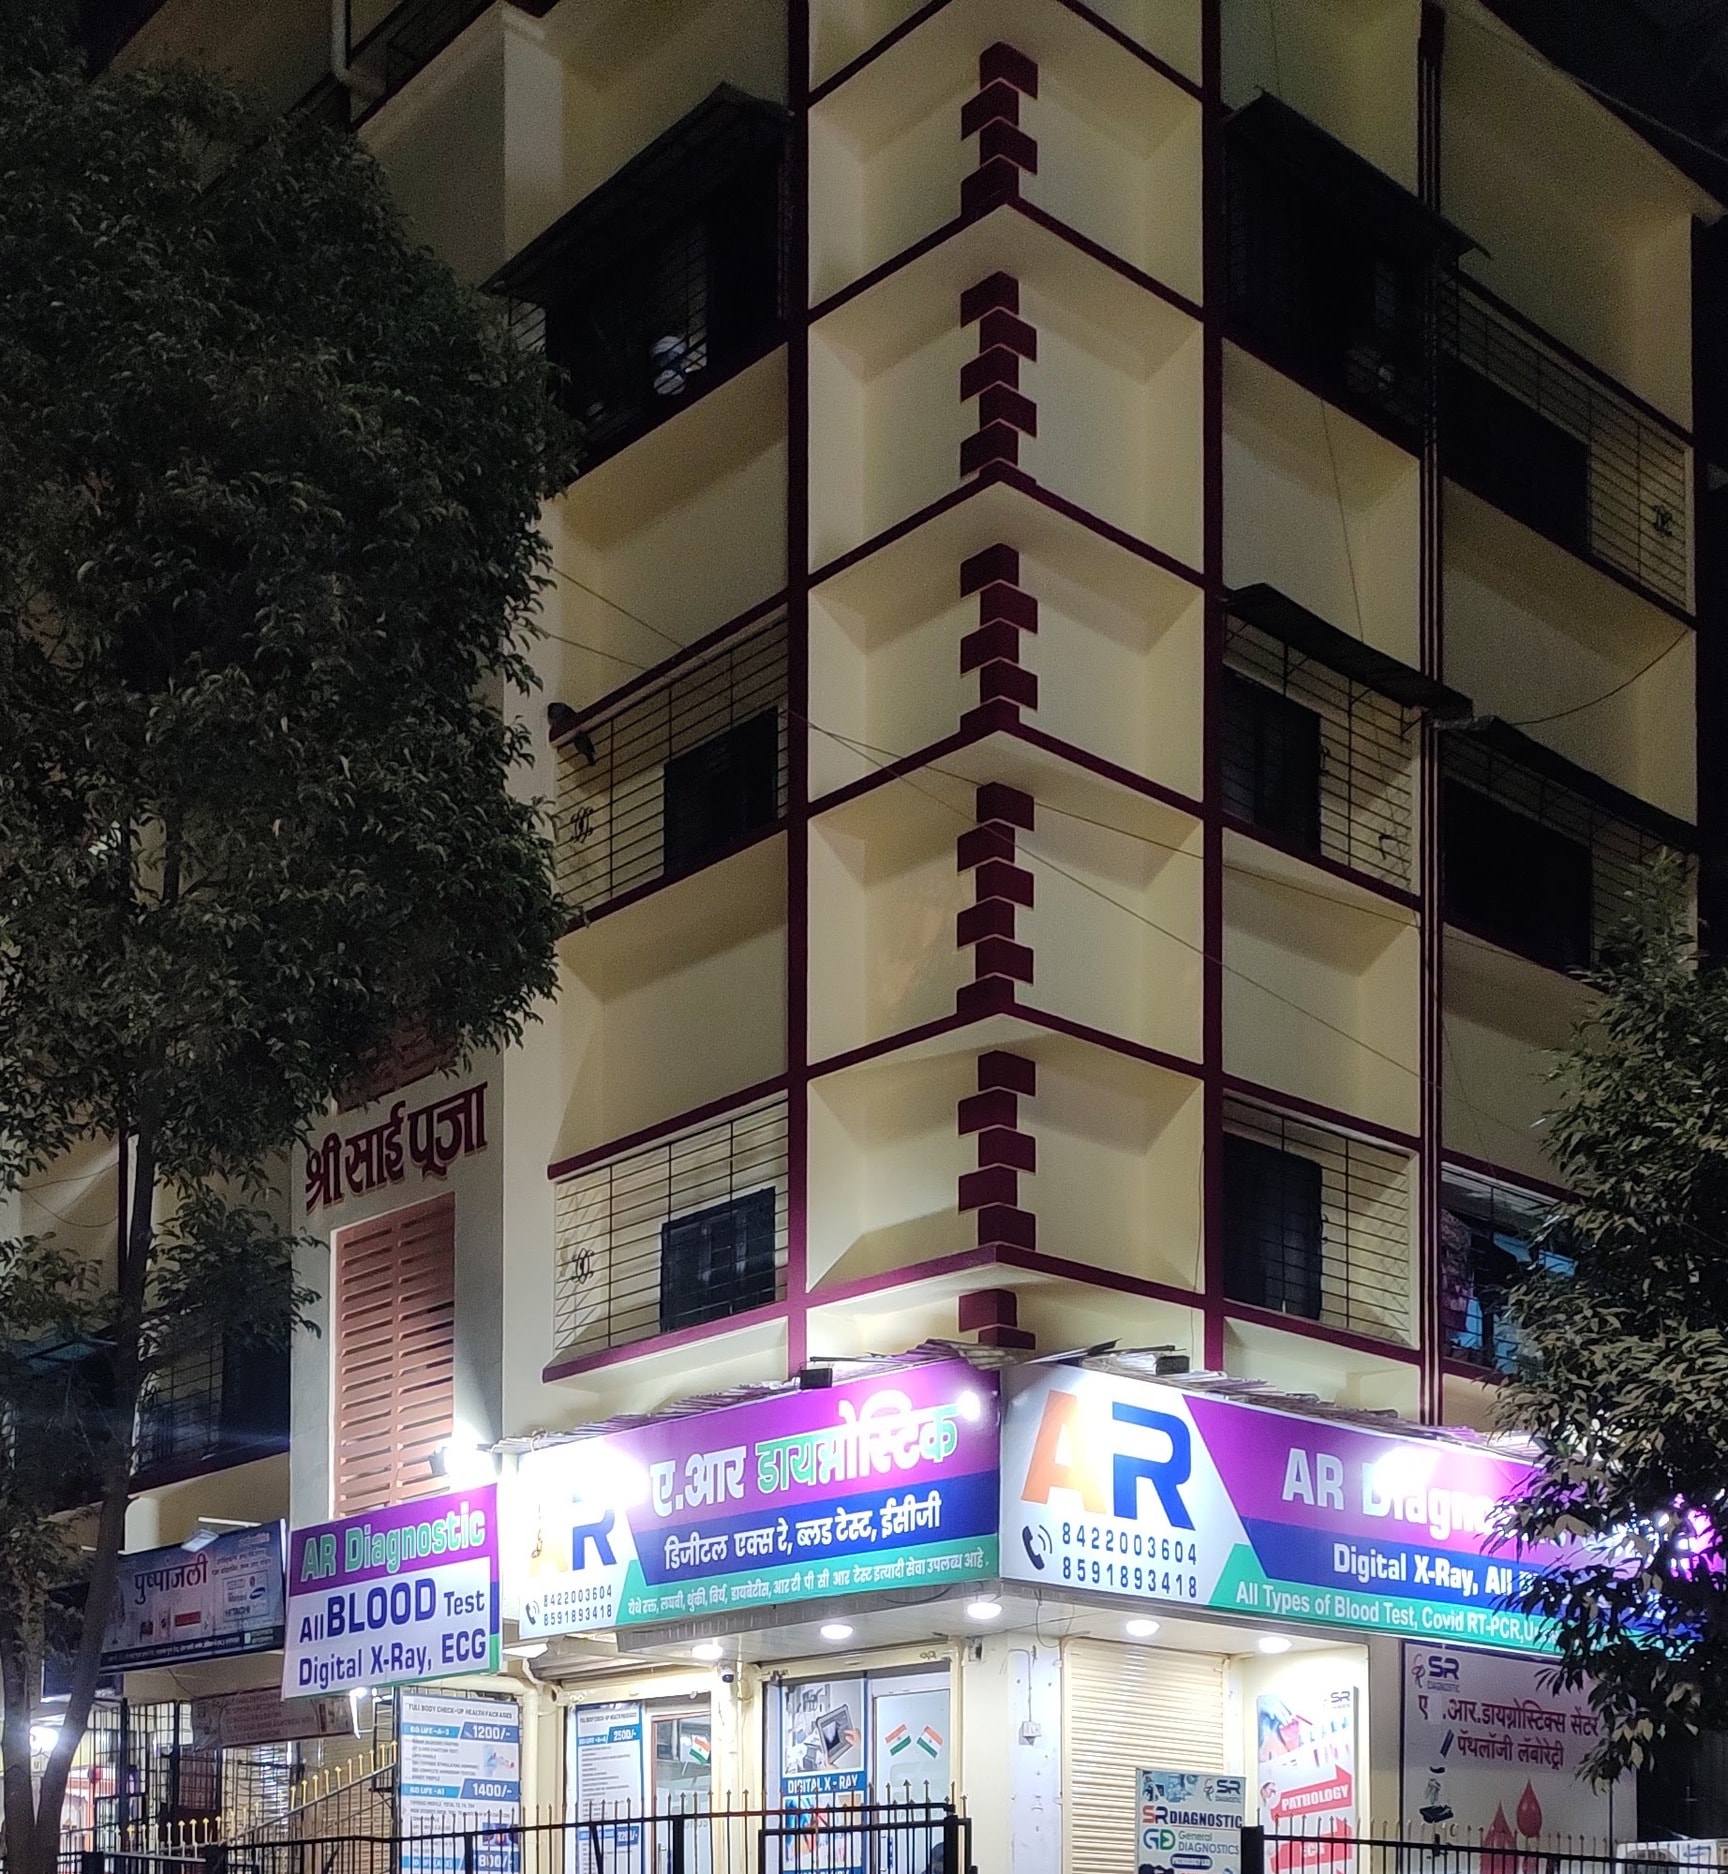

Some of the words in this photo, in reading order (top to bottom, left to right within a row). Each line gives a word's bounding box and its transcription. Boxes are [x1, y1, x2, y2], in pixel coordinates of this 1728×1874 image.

[306, 1132, 342, 1213] श्री
[345, 1100, 405, 1194] साई
[408, 1081, 488, 1178] पूजा
[1021, 1389, 1196, 1531] AR
[1282, 1447, 1344, 1511] AR
[301, 1533, 337, 1583] AR
[345, 1501, 486, 1574] Diagnostic
[664, 1532, 728, 1570] डिजीटल
[734, 1526, 774, 1558] एक्स
[880, 1490, 942, 1539] ईसीजी
[1062, 1522, 1197, 1566] 8422003604
[1063, 1556, 1197, 1598] 8591893418
[1334, 1543, 1407, 1584] Digital
[1413, 1554, 1478, 1597] X-Ray,
[300, 1614, 324, 1643] All
[327, 1578, 437, 1638] BLOOD
[444, 1590, 485, 1617] Test
[544, 1585, 612, 1607] 8422003604
[1236, 1581, 1258, 1606] All
[1262, 1584, 1310, 1615] Types
[1315, 1594, 1331, 1615] of
[1334, 1595, 1379, 1623] Blood
[1383, 1602, 1418, 1630] Test,
[1422, 1607, 1464, 1632] Covid
[544, 1604, 612, 1626] 8591893418
[299, 1649, 362, 1690] Digital
[370, 1642, 432, 1675] X-Ray,
[441, 1628, 486, 1664] ECG
[1429, 1655, 1460, 1680] SR
[472, 1725, 511, 1741] 1200/-
[473, 1783, 513, 1798] 1400/-
[788, 1777, 823, 1795] DIGITAL
[839, 1774, 859, 1788] RAY
[1216, 1780, 1241, 1794] SR
[1281, 1784, 1349, 1811] PATHOLOGY
[1142, 1805, 1169, 1824] SR
[1169, 1811, 1243, 1829] DIAGNOSTIC
[1178, 1831, 1212, 1841] General
[1178, 1841, 1239, 1855] DIAGNOSTICS
